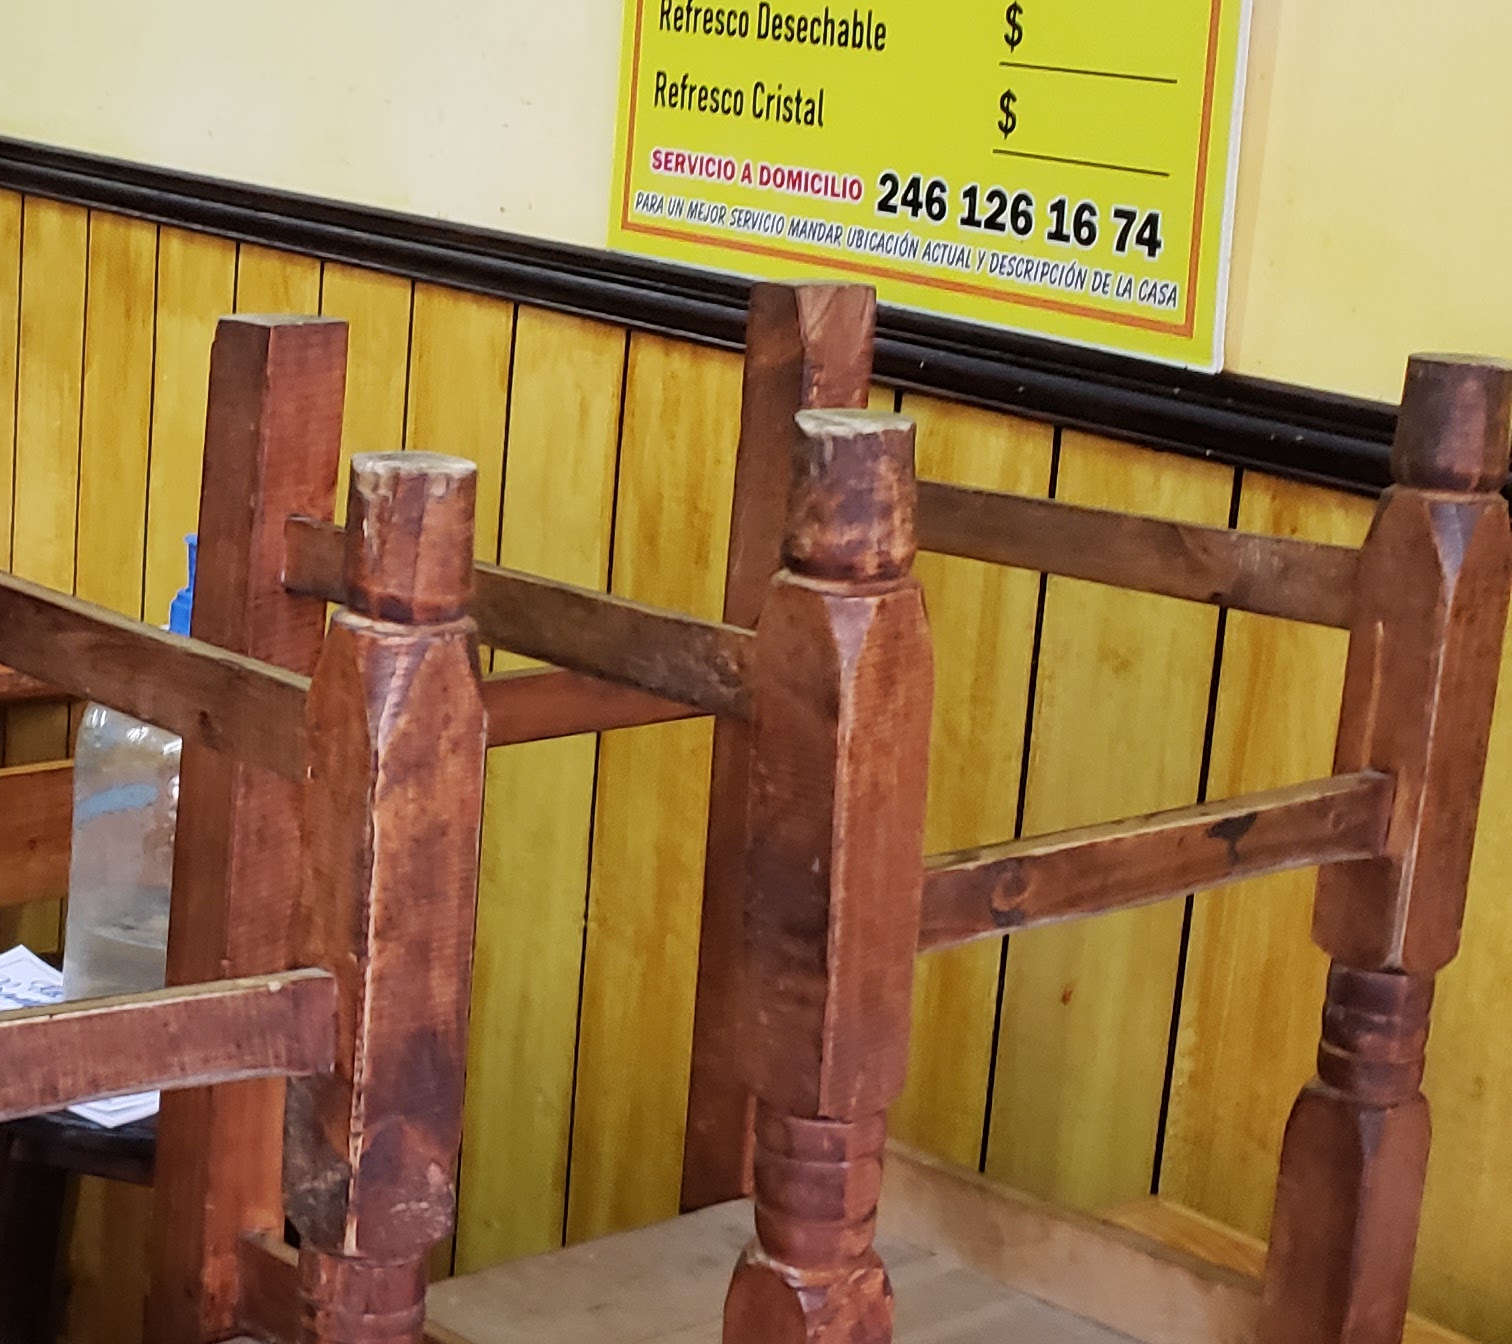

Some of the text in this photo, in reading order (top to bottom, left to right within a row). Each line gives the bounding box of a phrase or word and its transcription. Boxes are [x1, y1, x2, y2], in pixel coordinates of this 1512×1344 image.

[756, 1, 887, 52] Desechable
[1003, 0, 1024, 54] $
[653, 70, 1017, 140] Refresco Cristal $
[651, 148, 1163, 258] SERVICIO A DOMICILIO 246 126 16 74
[634, 191, 1179, 308] PARA UN MEJOR SERVICIO MANDAR UBICACIÓN ACTUAL Y DESCRIPCIÓN DE LA CASA
